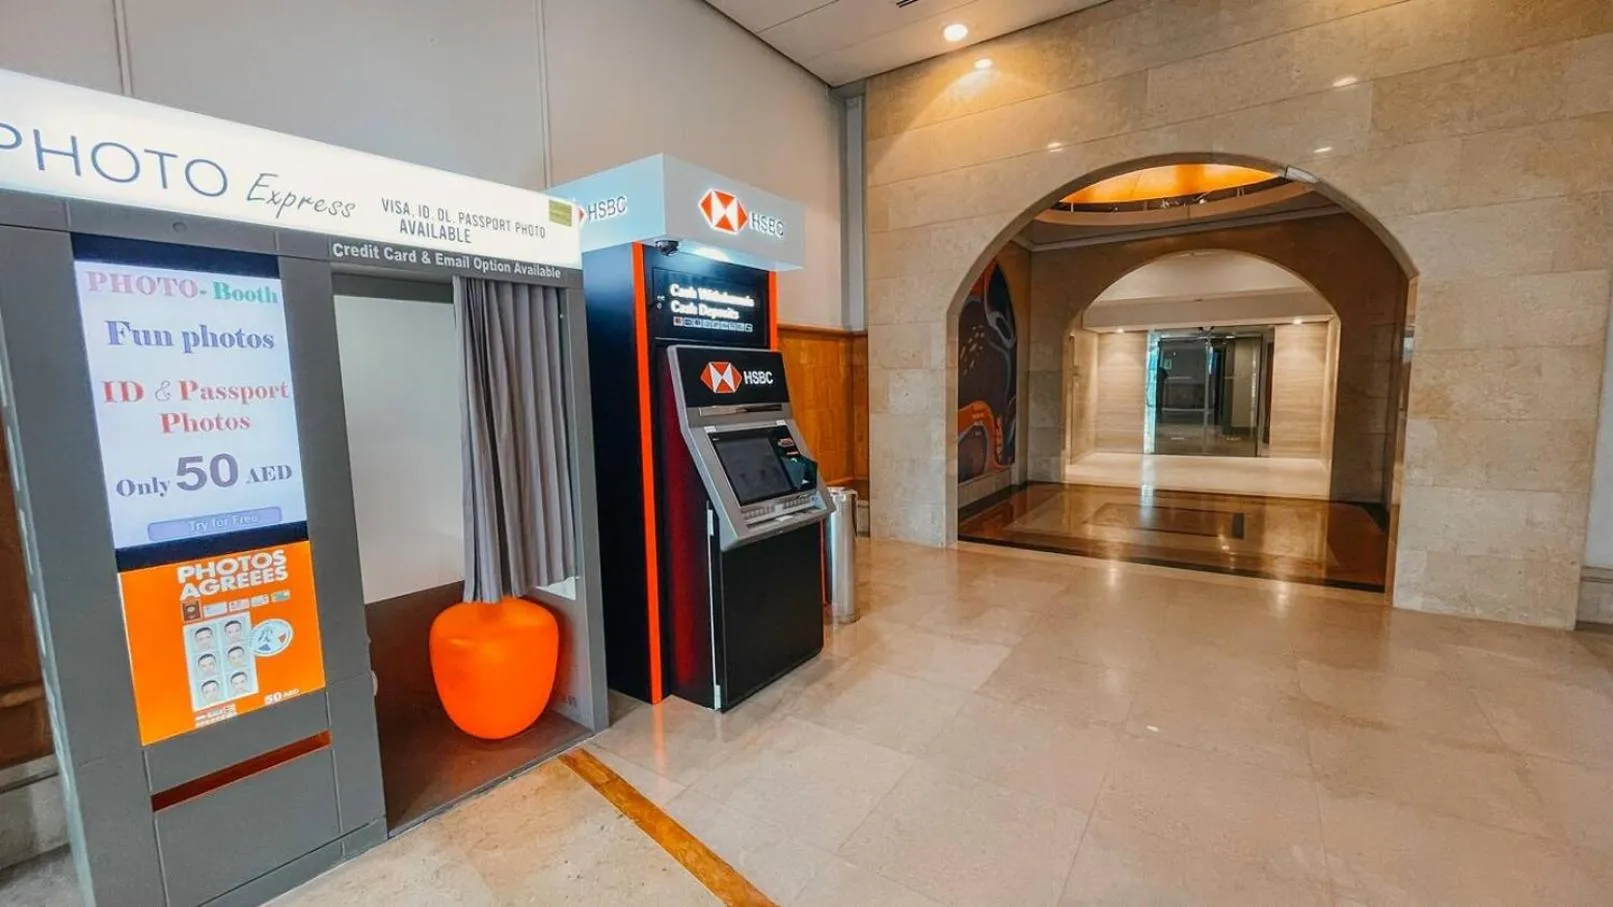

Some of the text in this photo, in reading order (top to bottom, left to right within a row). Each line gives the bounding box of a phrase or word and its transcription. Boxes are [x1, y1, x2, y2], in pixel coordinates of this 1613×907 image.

[246, 172, 356, 219] Express
[588, 195, 627, 220] HSBC
[399, 218, 472, 243] AVAILABLE
[458, 211, 511, 232] PASSPORT
[514, 221, 546, 239] PHOTO
[750, 211, 784, 238] HSBC
[332, 242, 561, 278] Credit Card & Email Option Available
[212, 280, 278, 304] Booth
[670, 283, 698, 299] Cash
[670, 300, 698, 315] Cash
[105, 320, 275, 354] Fun photos
[743, 370, 774, 384] HSBC
[101, 379, 290, 405] ID & Passport
[160, 412, 252, 434] Photos
[115, 453, 292, 498] Only 50 AED
[190, 520, 209, 533] Try
[212, 518, 228, 527] for
[177, 549, 287, 583] PHOTOS
[180, 566, 289, 600] AGREEES
[264, 691, 282, 706] 50
